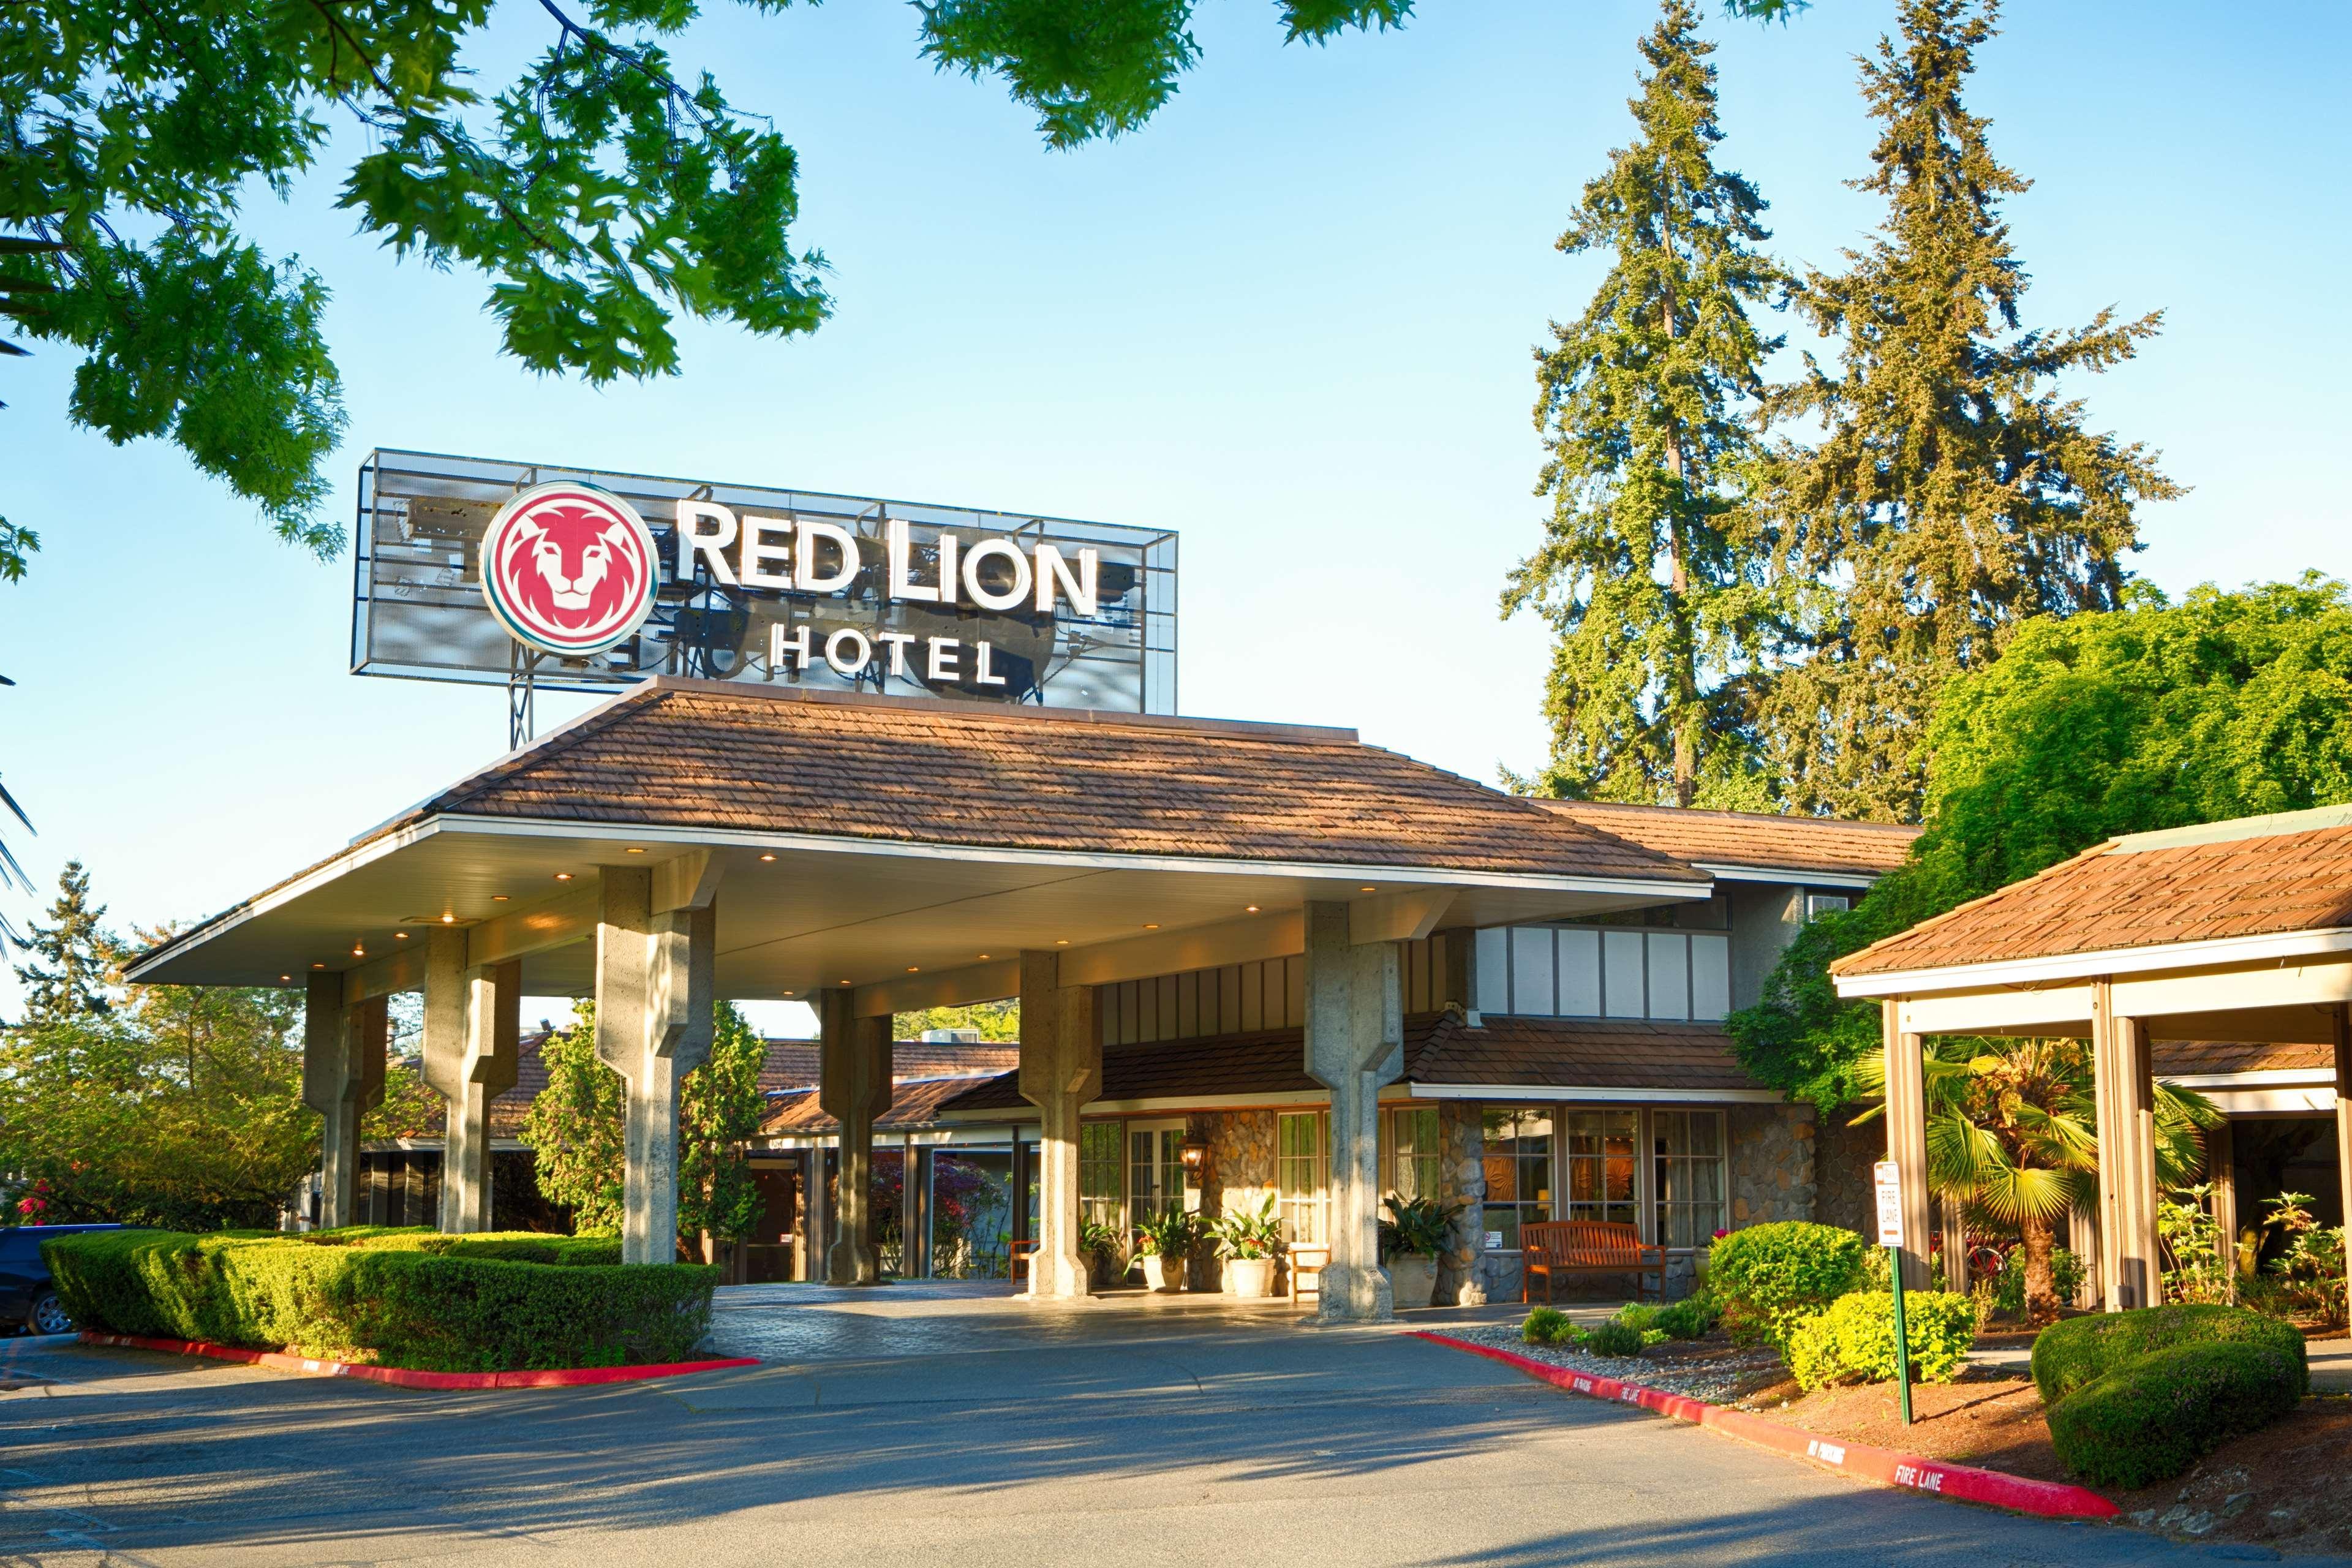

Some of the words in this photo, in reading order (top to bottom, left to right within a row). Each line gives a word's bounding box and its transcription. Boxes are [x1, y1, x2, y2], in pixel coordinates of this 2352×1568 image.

[677, 499, 860, 593] RED
[888, 519, 1097, 616] LION
[771, 623, 1005, 685] HOTEL
[1881, 1190, 1896, 1205] FIRE
[1882, 1208, 1898, 1223] LANE
[1807, 1440, 1818, 1456] NO
[1818, 1442, 1845, 1464] PARKING
[1894, 1464, 1917, 1486] FIRE
[1918, 1470, 1943, 1491] LANE
